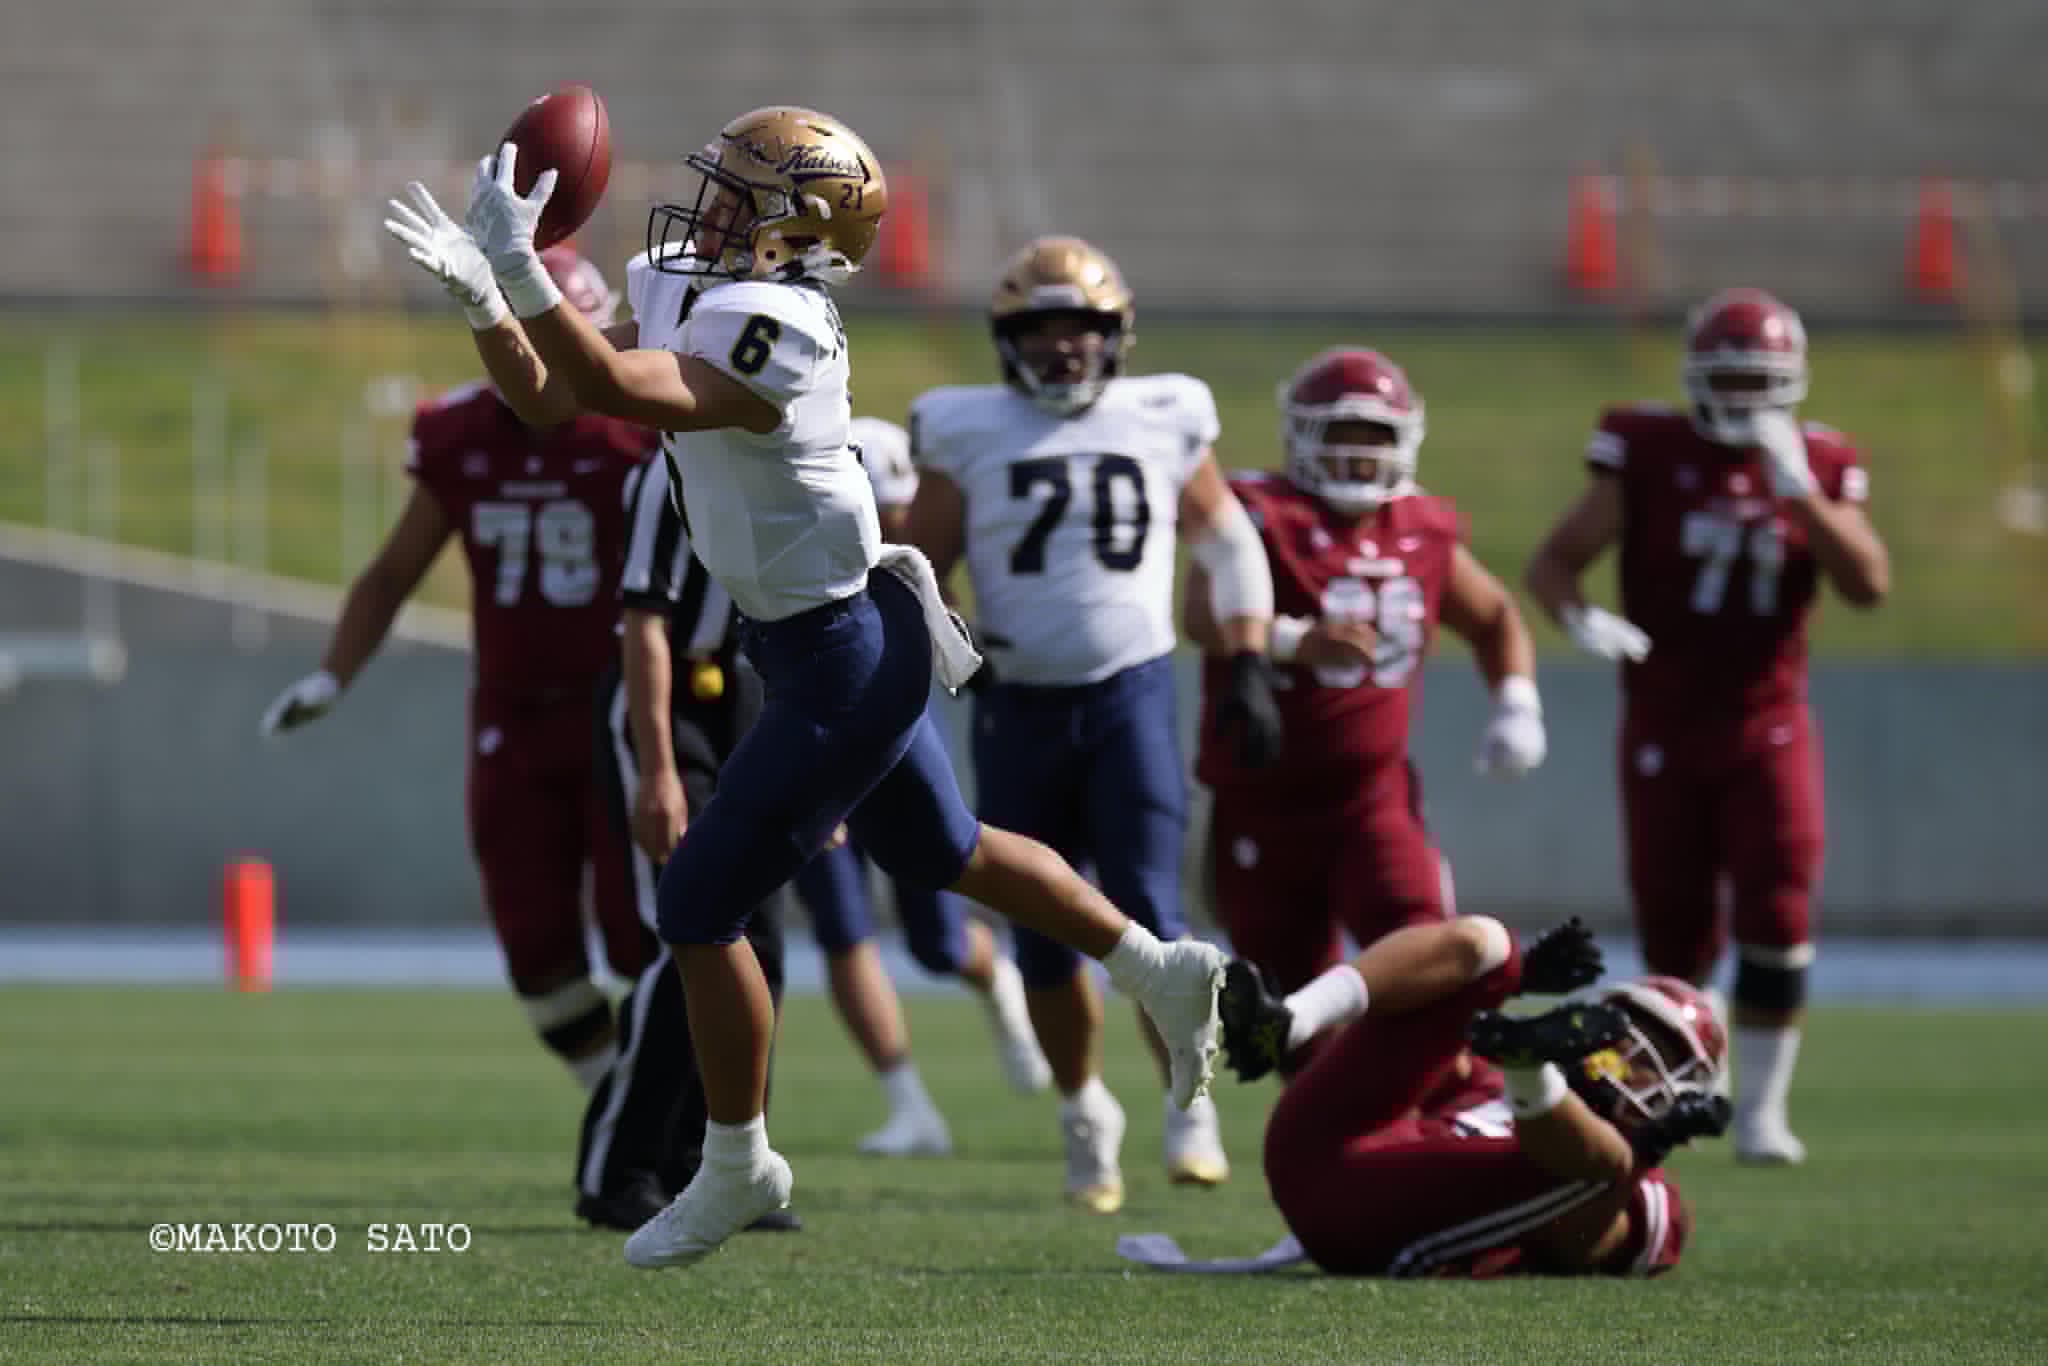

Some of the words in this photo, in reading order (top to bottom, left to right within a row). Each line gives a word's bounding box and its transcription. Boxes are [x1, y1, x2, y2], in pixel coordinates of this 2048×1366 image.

[840, 183, 864, 211] 21
[730, 313, 782, 376] 6
[1009, 453, 1150, 574] 70
[1682, 510, 1786, 615] 71
